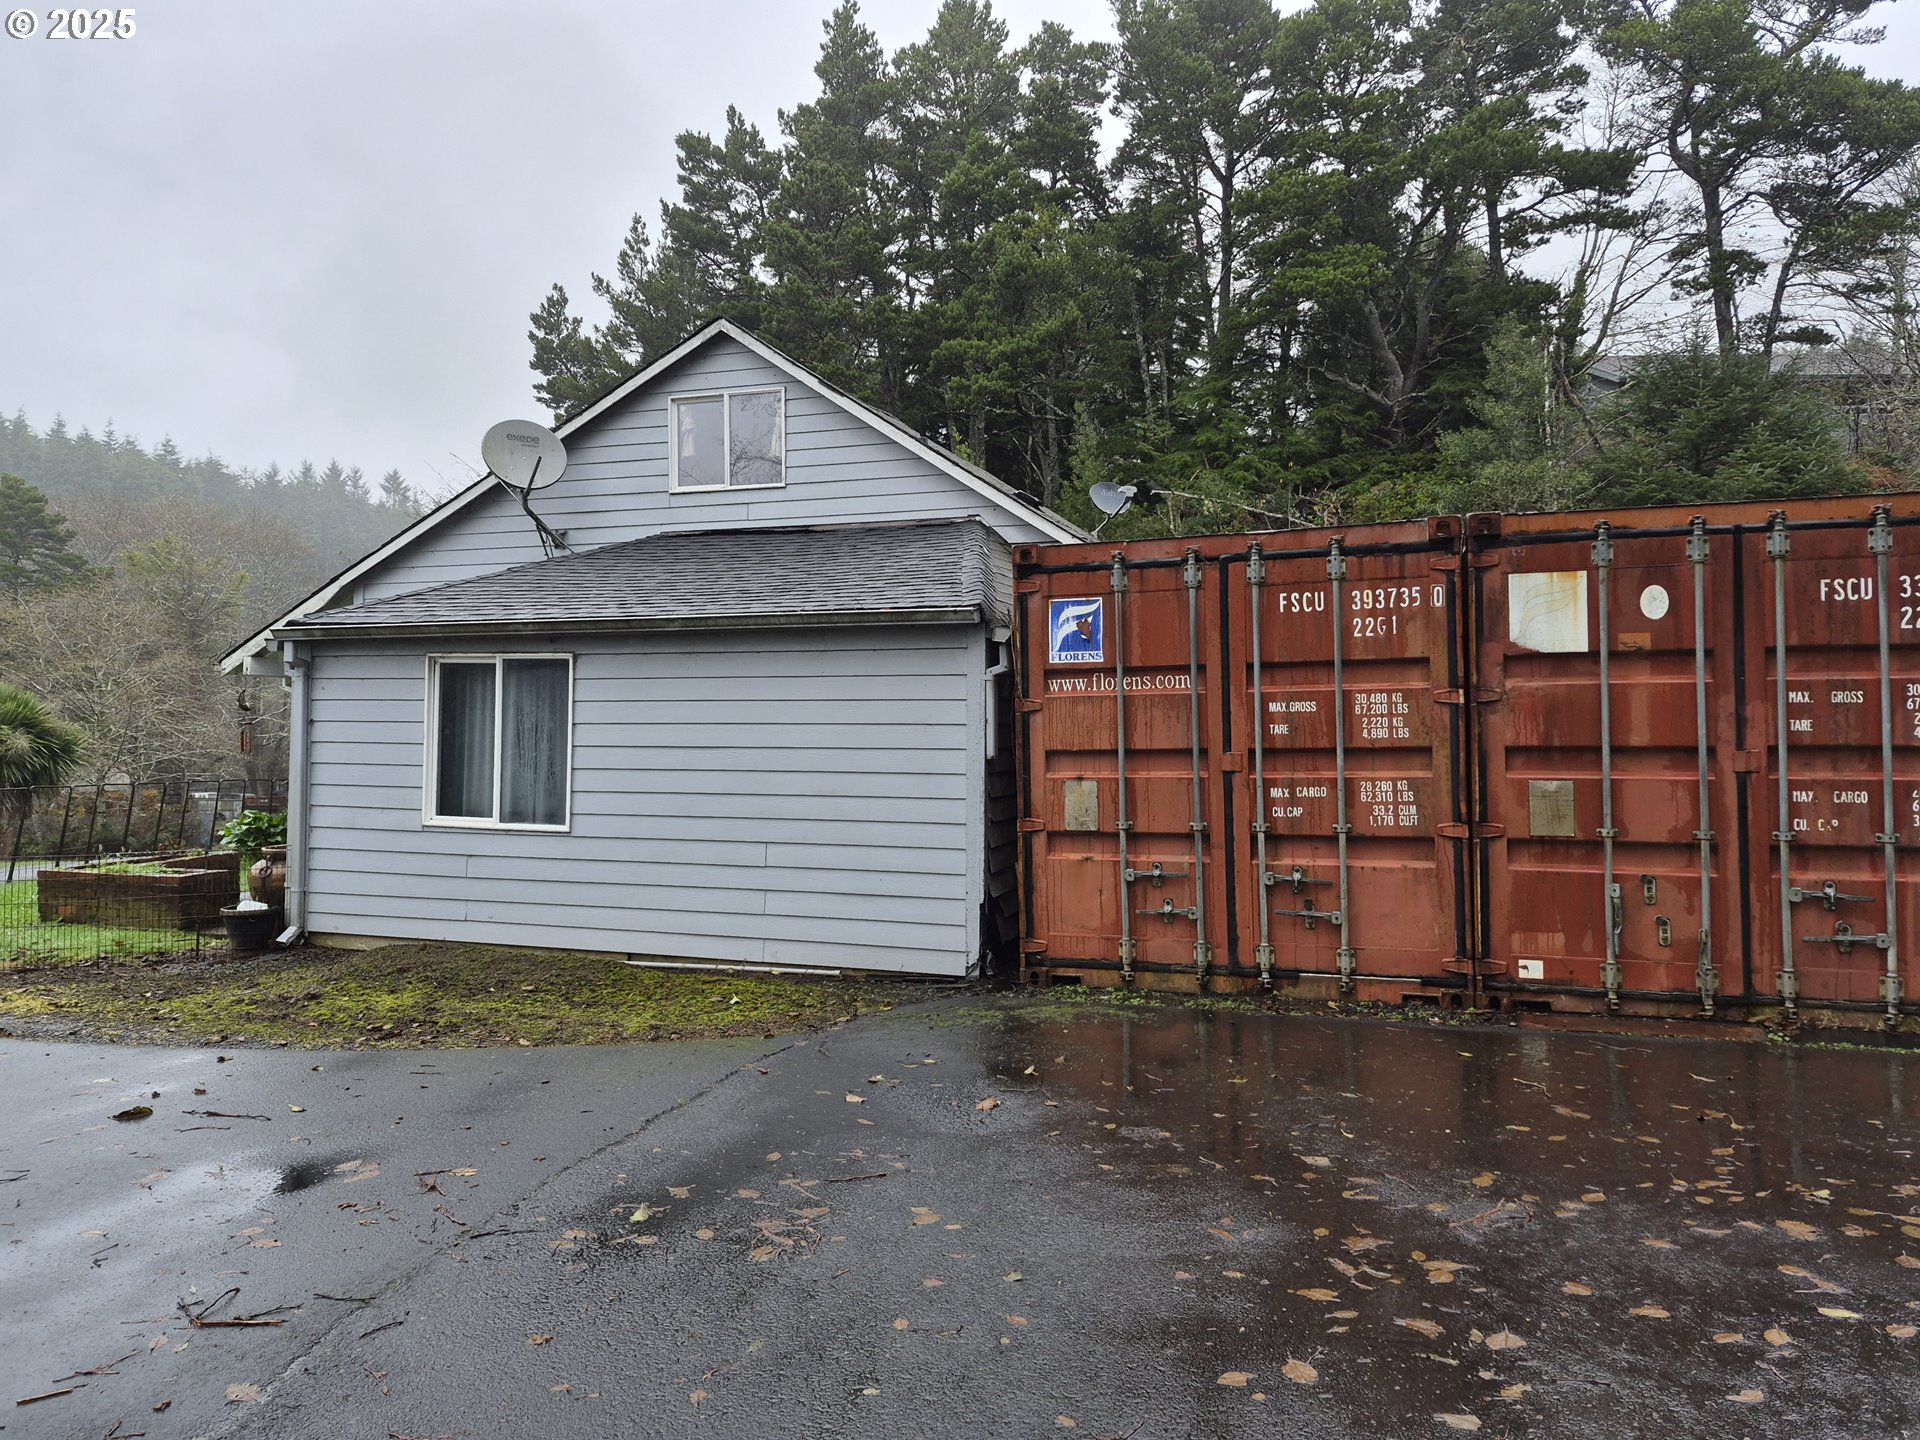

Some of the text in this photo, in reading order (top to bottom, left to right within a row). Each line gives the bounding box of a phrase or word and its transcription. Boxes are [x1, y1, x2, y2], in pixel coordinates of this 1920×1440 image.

[1820, 577, 1873, 601] FSCU
[1279, 586, 1443, 613] FSCU 393735 0
[1353, 615, 1397, 637] 22G1
[1051, 652, 1103, 662] FLORENS
[1355, 692, 1402, 705] 30,480 KG
[1788, 690, 1864, 703] MAX. GROSS
[1355, 703, 1409, 715] 67,200 LBS
[1362, 716, 1404, 729] 2,220 KG
[1789, 719, 1814, 731] TARE
[1269, 724, 1289, 735] TARE
[1362, 727, 1410, 739] 4,890 LBS
[1270, 786, 1327, 798] MAX CARGO
[1360, 780, 1408, 792] 28,260 KG
[1360, 791, 1414, 803] 62,310 LBS
[1833, 790, 1869, 804] CARGO
[1372, 805, 1394, 816] 33.2
[1369, 815, 1394, 827] 1,170
[1793, 818, 1810, 831] CU.
